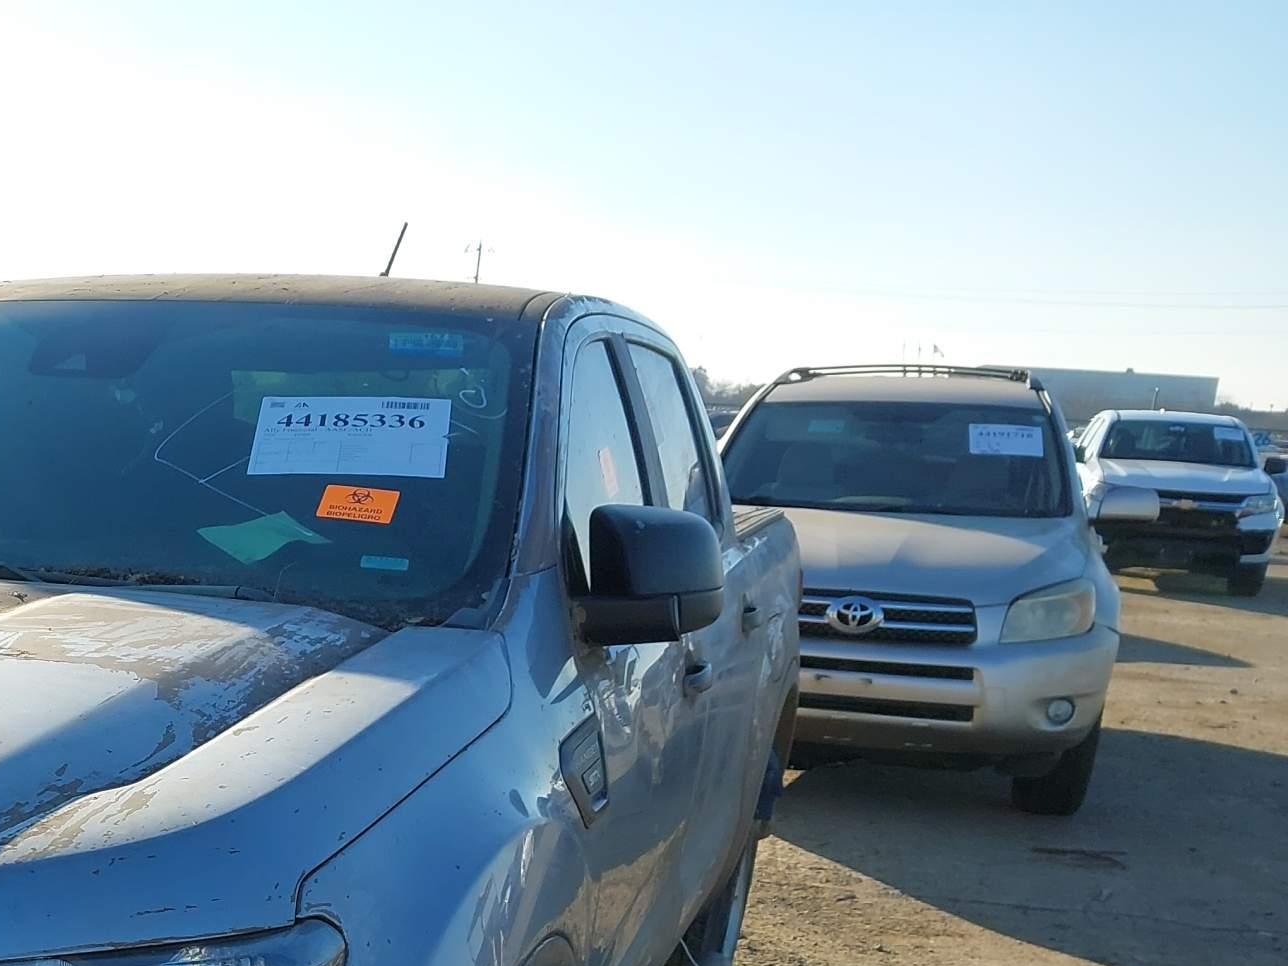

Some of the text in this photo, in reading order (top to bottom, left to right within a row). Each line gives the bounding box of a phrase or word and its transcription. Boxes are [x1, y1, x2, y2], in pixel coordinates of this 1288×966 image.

[276, 413, 426, 429] 44185336
[328, 504, 383, 514] BIOHAZARD
[326, 510, 381, 521] BIOPELIGRO
